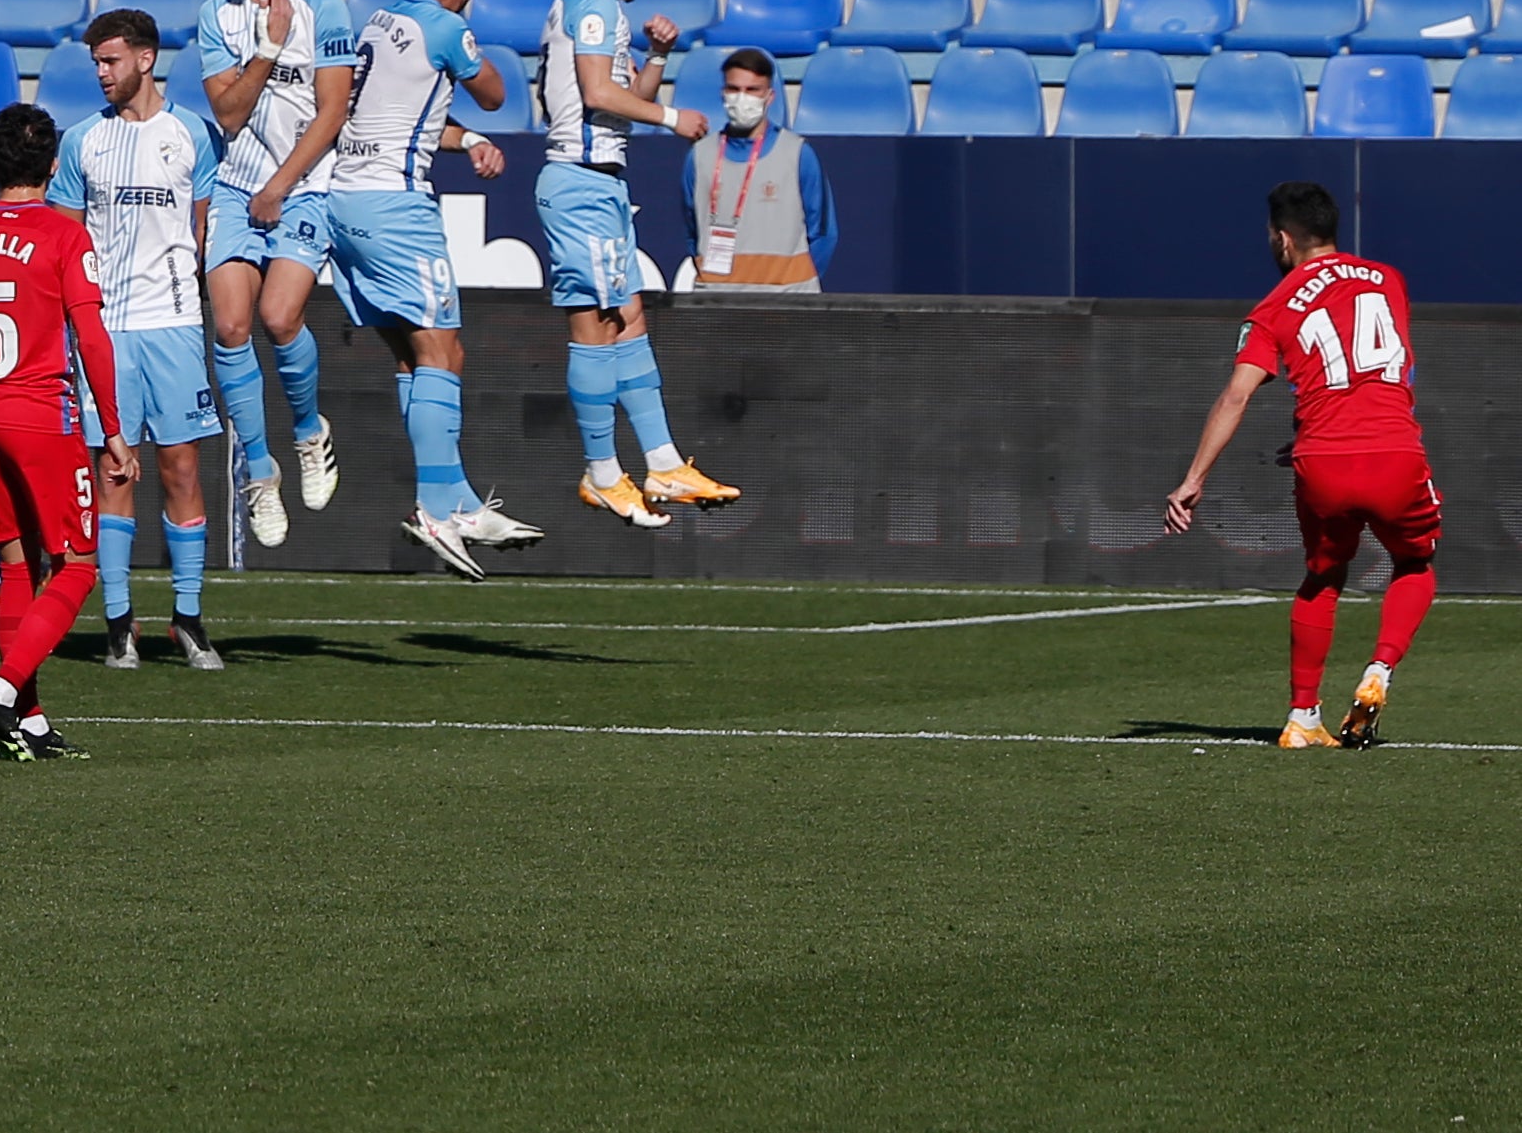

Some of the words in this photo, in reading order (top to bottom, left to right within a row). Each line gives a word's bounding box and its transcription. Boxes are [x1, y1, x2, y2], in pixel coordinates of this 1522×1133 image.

[113, 185, 178, 209] TESESA
[432, 257, 452, 293] 9
[1286, 266, 1336, 314] FEDE
[1296, 291, 1406, 390] 14
[74, 467, 93, 508] 5
